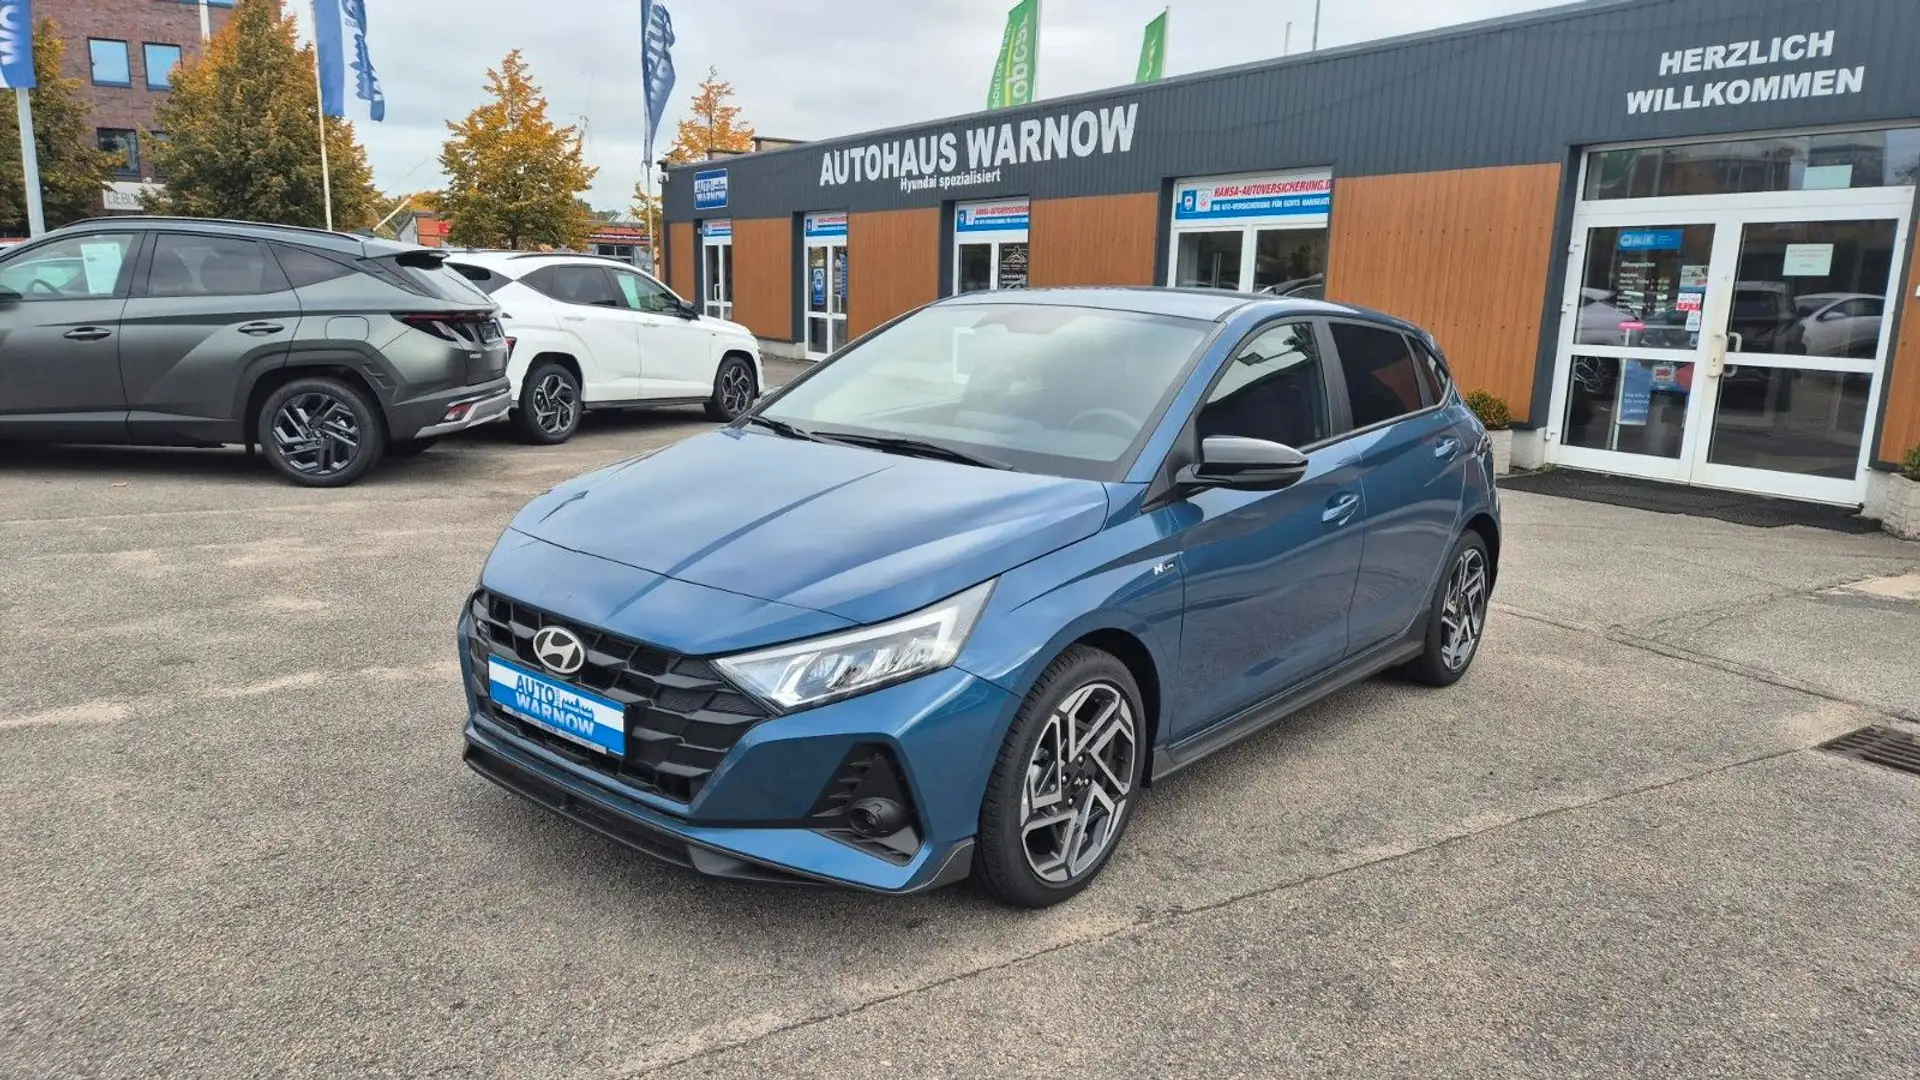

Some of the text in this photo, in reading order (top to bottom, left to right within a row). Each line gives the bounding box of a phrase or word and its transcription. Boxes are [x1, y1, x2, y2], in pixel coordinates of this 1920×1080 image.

[1659, 30, 1835, 76] HERZLICH
[1627, 66, 1865, 115] WILLKOMMEN
[819, 102, 1139, 187] AUTOHAUS WARNOW
[900, 170, 1002, 194] Hyundai spezialisiert
[516, 675, 555, 704] AUTO
[515, 691, 595, 737] WARNOW
